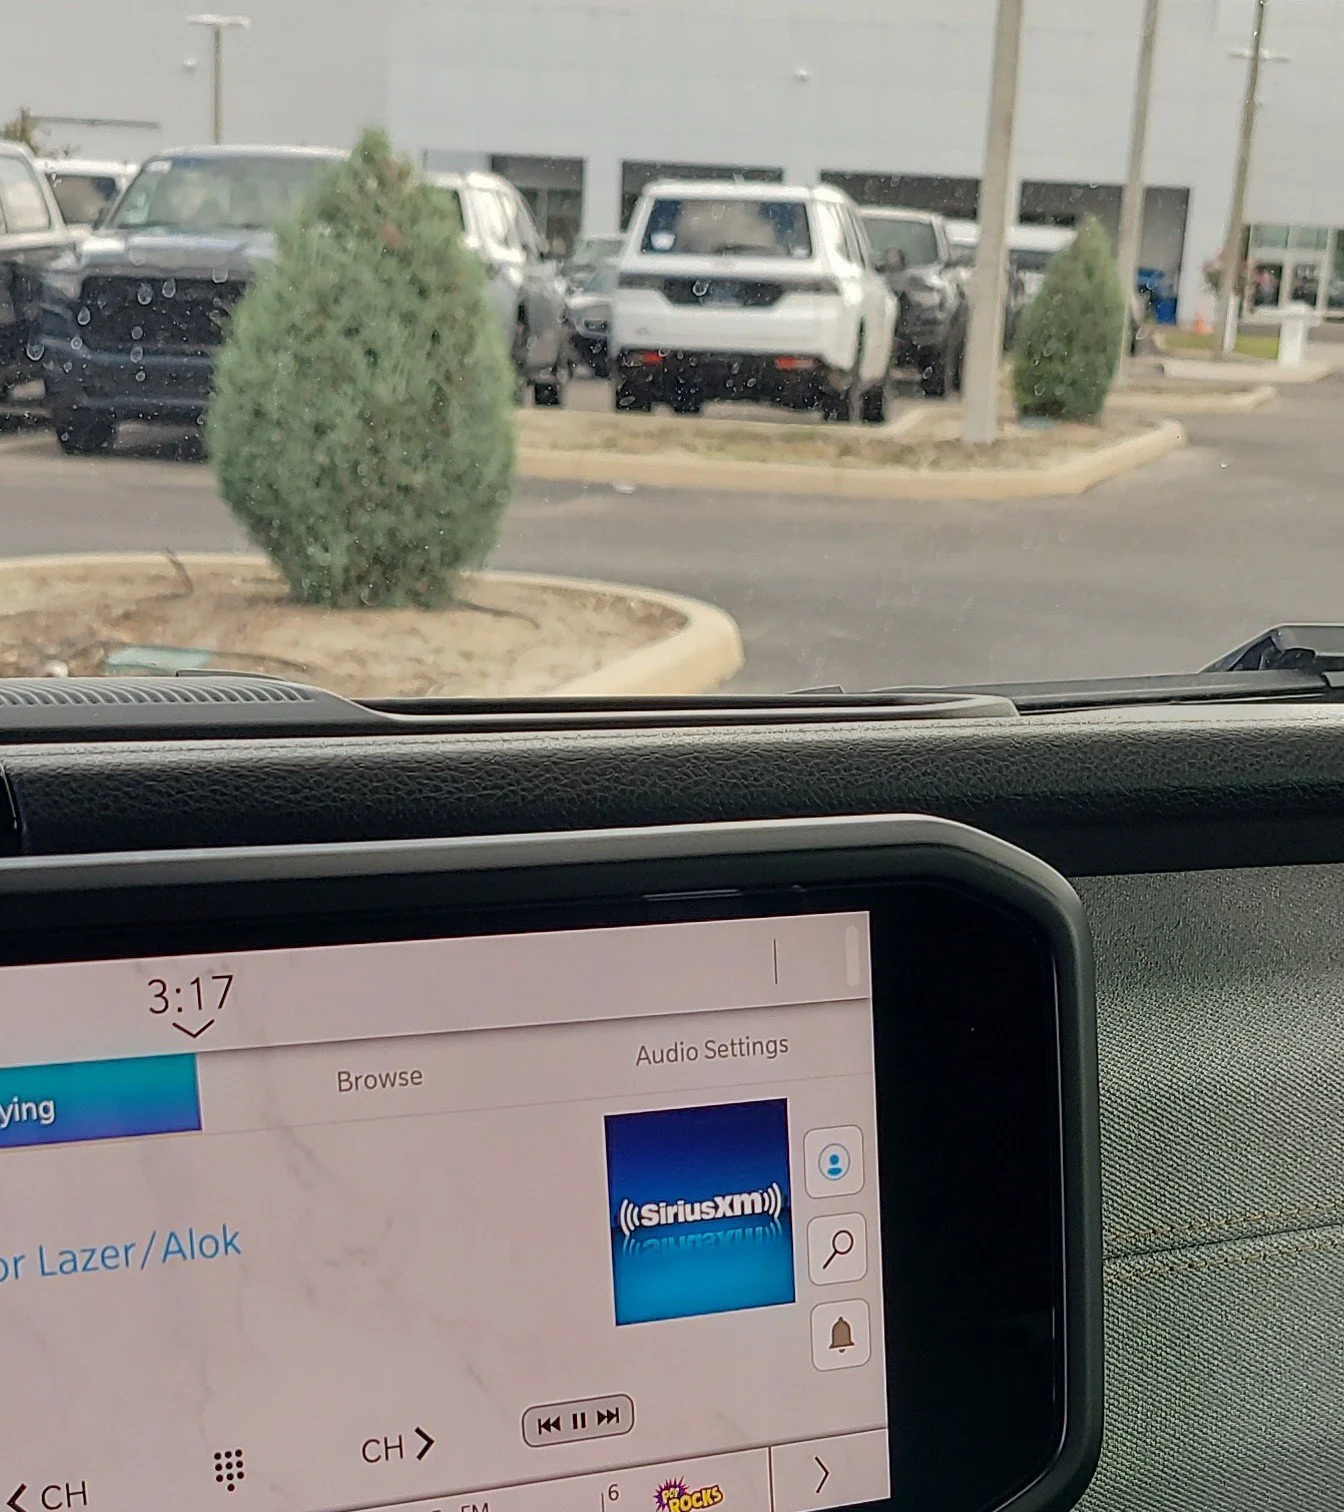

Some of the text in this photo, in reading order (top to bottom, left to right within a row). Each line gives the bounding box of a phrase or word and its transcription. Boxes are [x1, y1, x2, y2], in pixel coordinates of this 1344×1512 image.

[148, 974, 233, 1015] 3:17
[636, 1035, 789, 1066] Audio Settings
[336, 1066, 423, 1092] Browse
[39, 1223, 241, 1278] Lazer/Alok
[362, 1436, 404, 1464] CH
[41, 1481, 88, 1511] CH
[609, 1484, 619, 1500] 6
